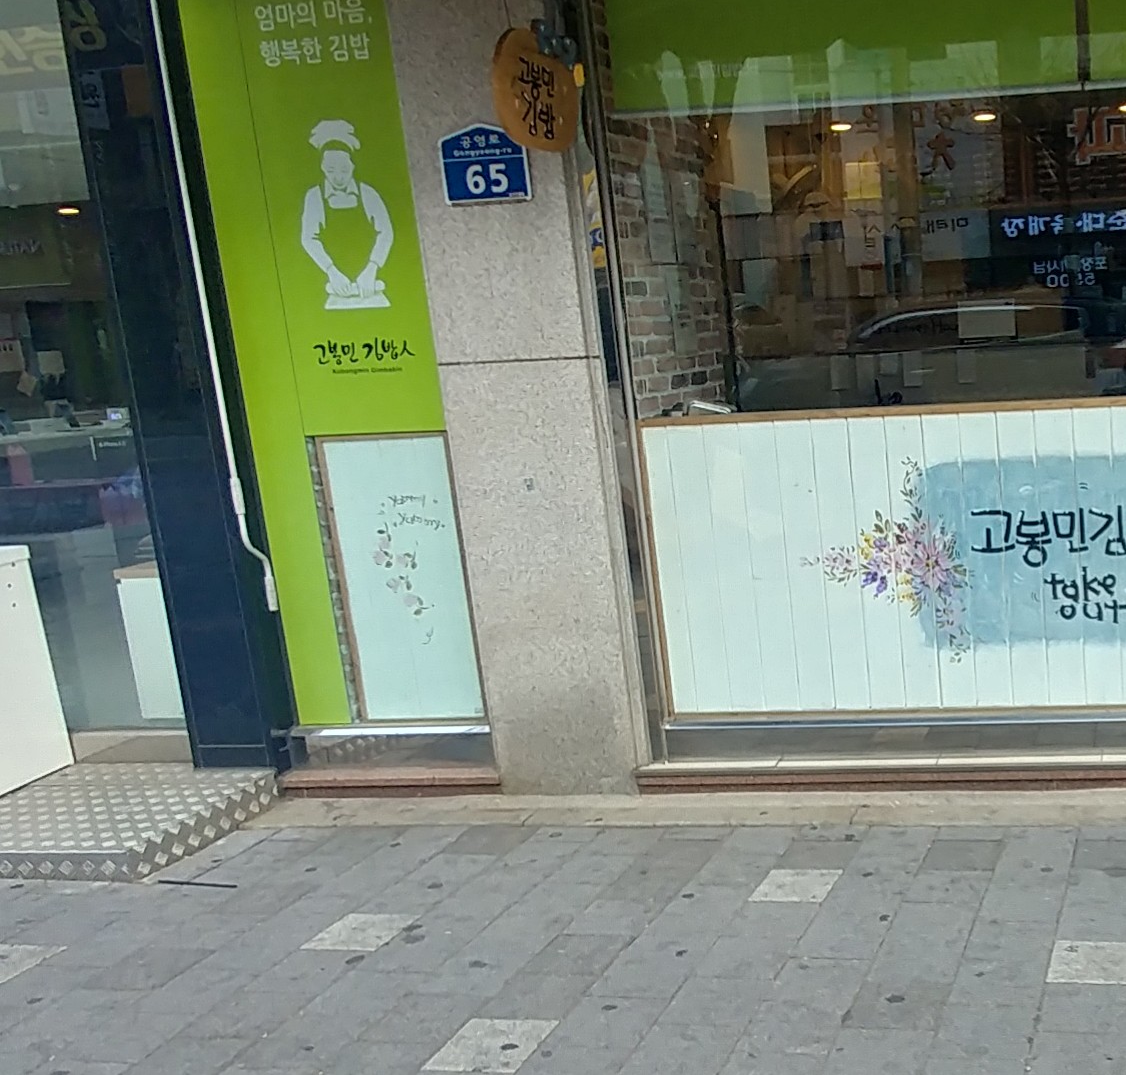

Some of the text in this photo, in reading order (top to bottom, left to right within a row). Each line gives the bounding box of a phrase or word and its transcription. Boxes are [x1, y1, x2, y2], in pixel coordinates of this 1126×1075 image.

[254, 0, 317, 32] 엄마의
[259, 32, 370, 67] 행복한 김밥
[517, 56, 556, 100] 고봉민
[521, 90, 556, 141] 김밥
[459, 133, 502, 149] 공영로
[465, 162, 510, 195] 65
[312, 339, 359, 366] 고봉민
[1043, 565, 1118, 604] take
